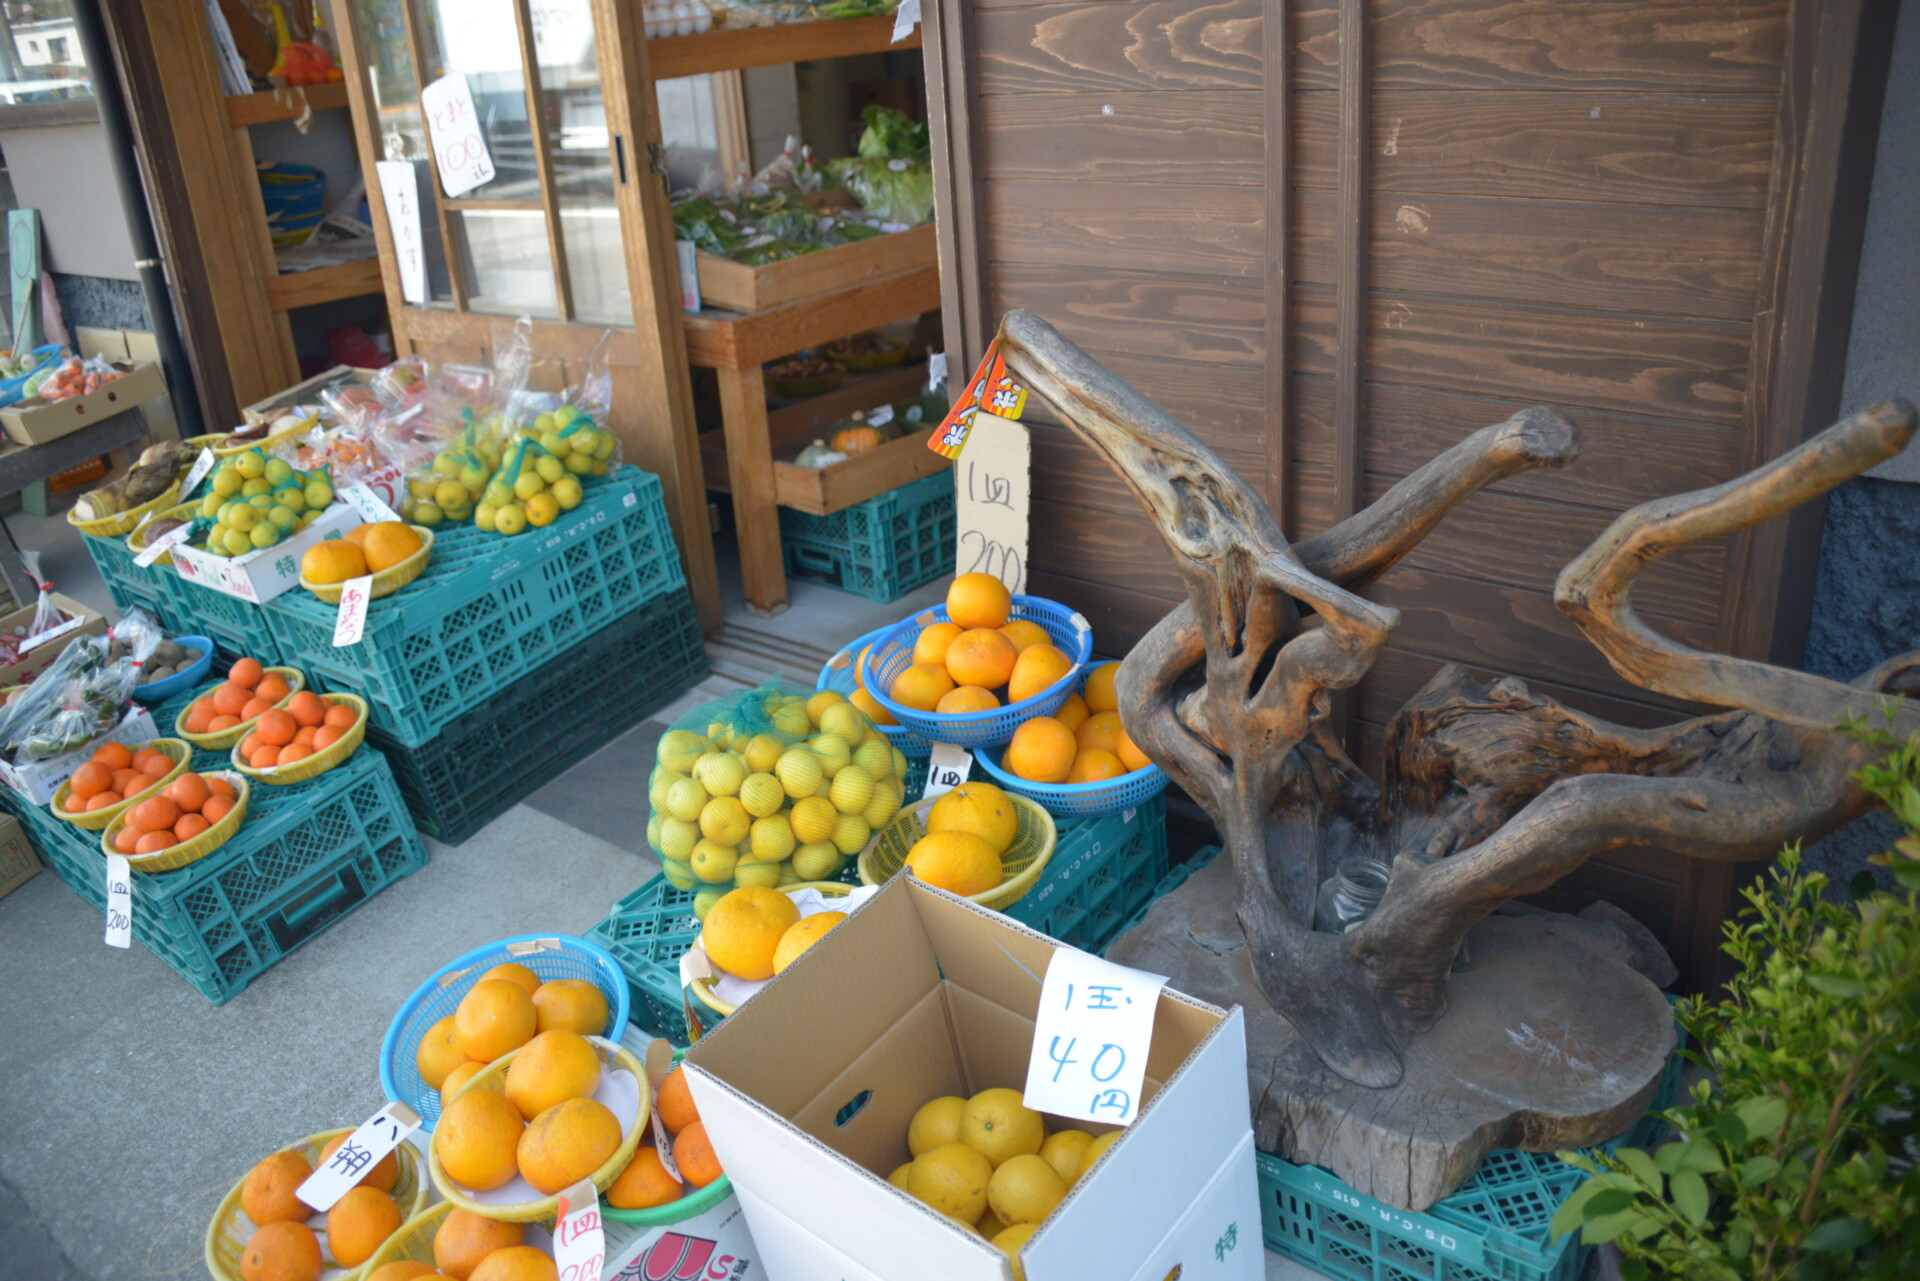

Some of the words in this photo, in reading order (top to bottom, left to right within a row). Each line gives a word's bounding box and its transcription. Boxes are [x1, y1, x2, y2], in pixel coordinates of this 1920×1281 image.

[434, 97, 469, 132] とまと
[438, 133, 485, 175] 100
[1058, 852, 1092, 880] S.C.R.
[108, 909, 129, 930] 200
[1049, 1035, 1126, 1083] 40
[1090, 1088, 1130, 1118] 円
[1333, 1190, 1360, 1207] 615
[1372, 1205, 1436, 1240] S.C.R.
